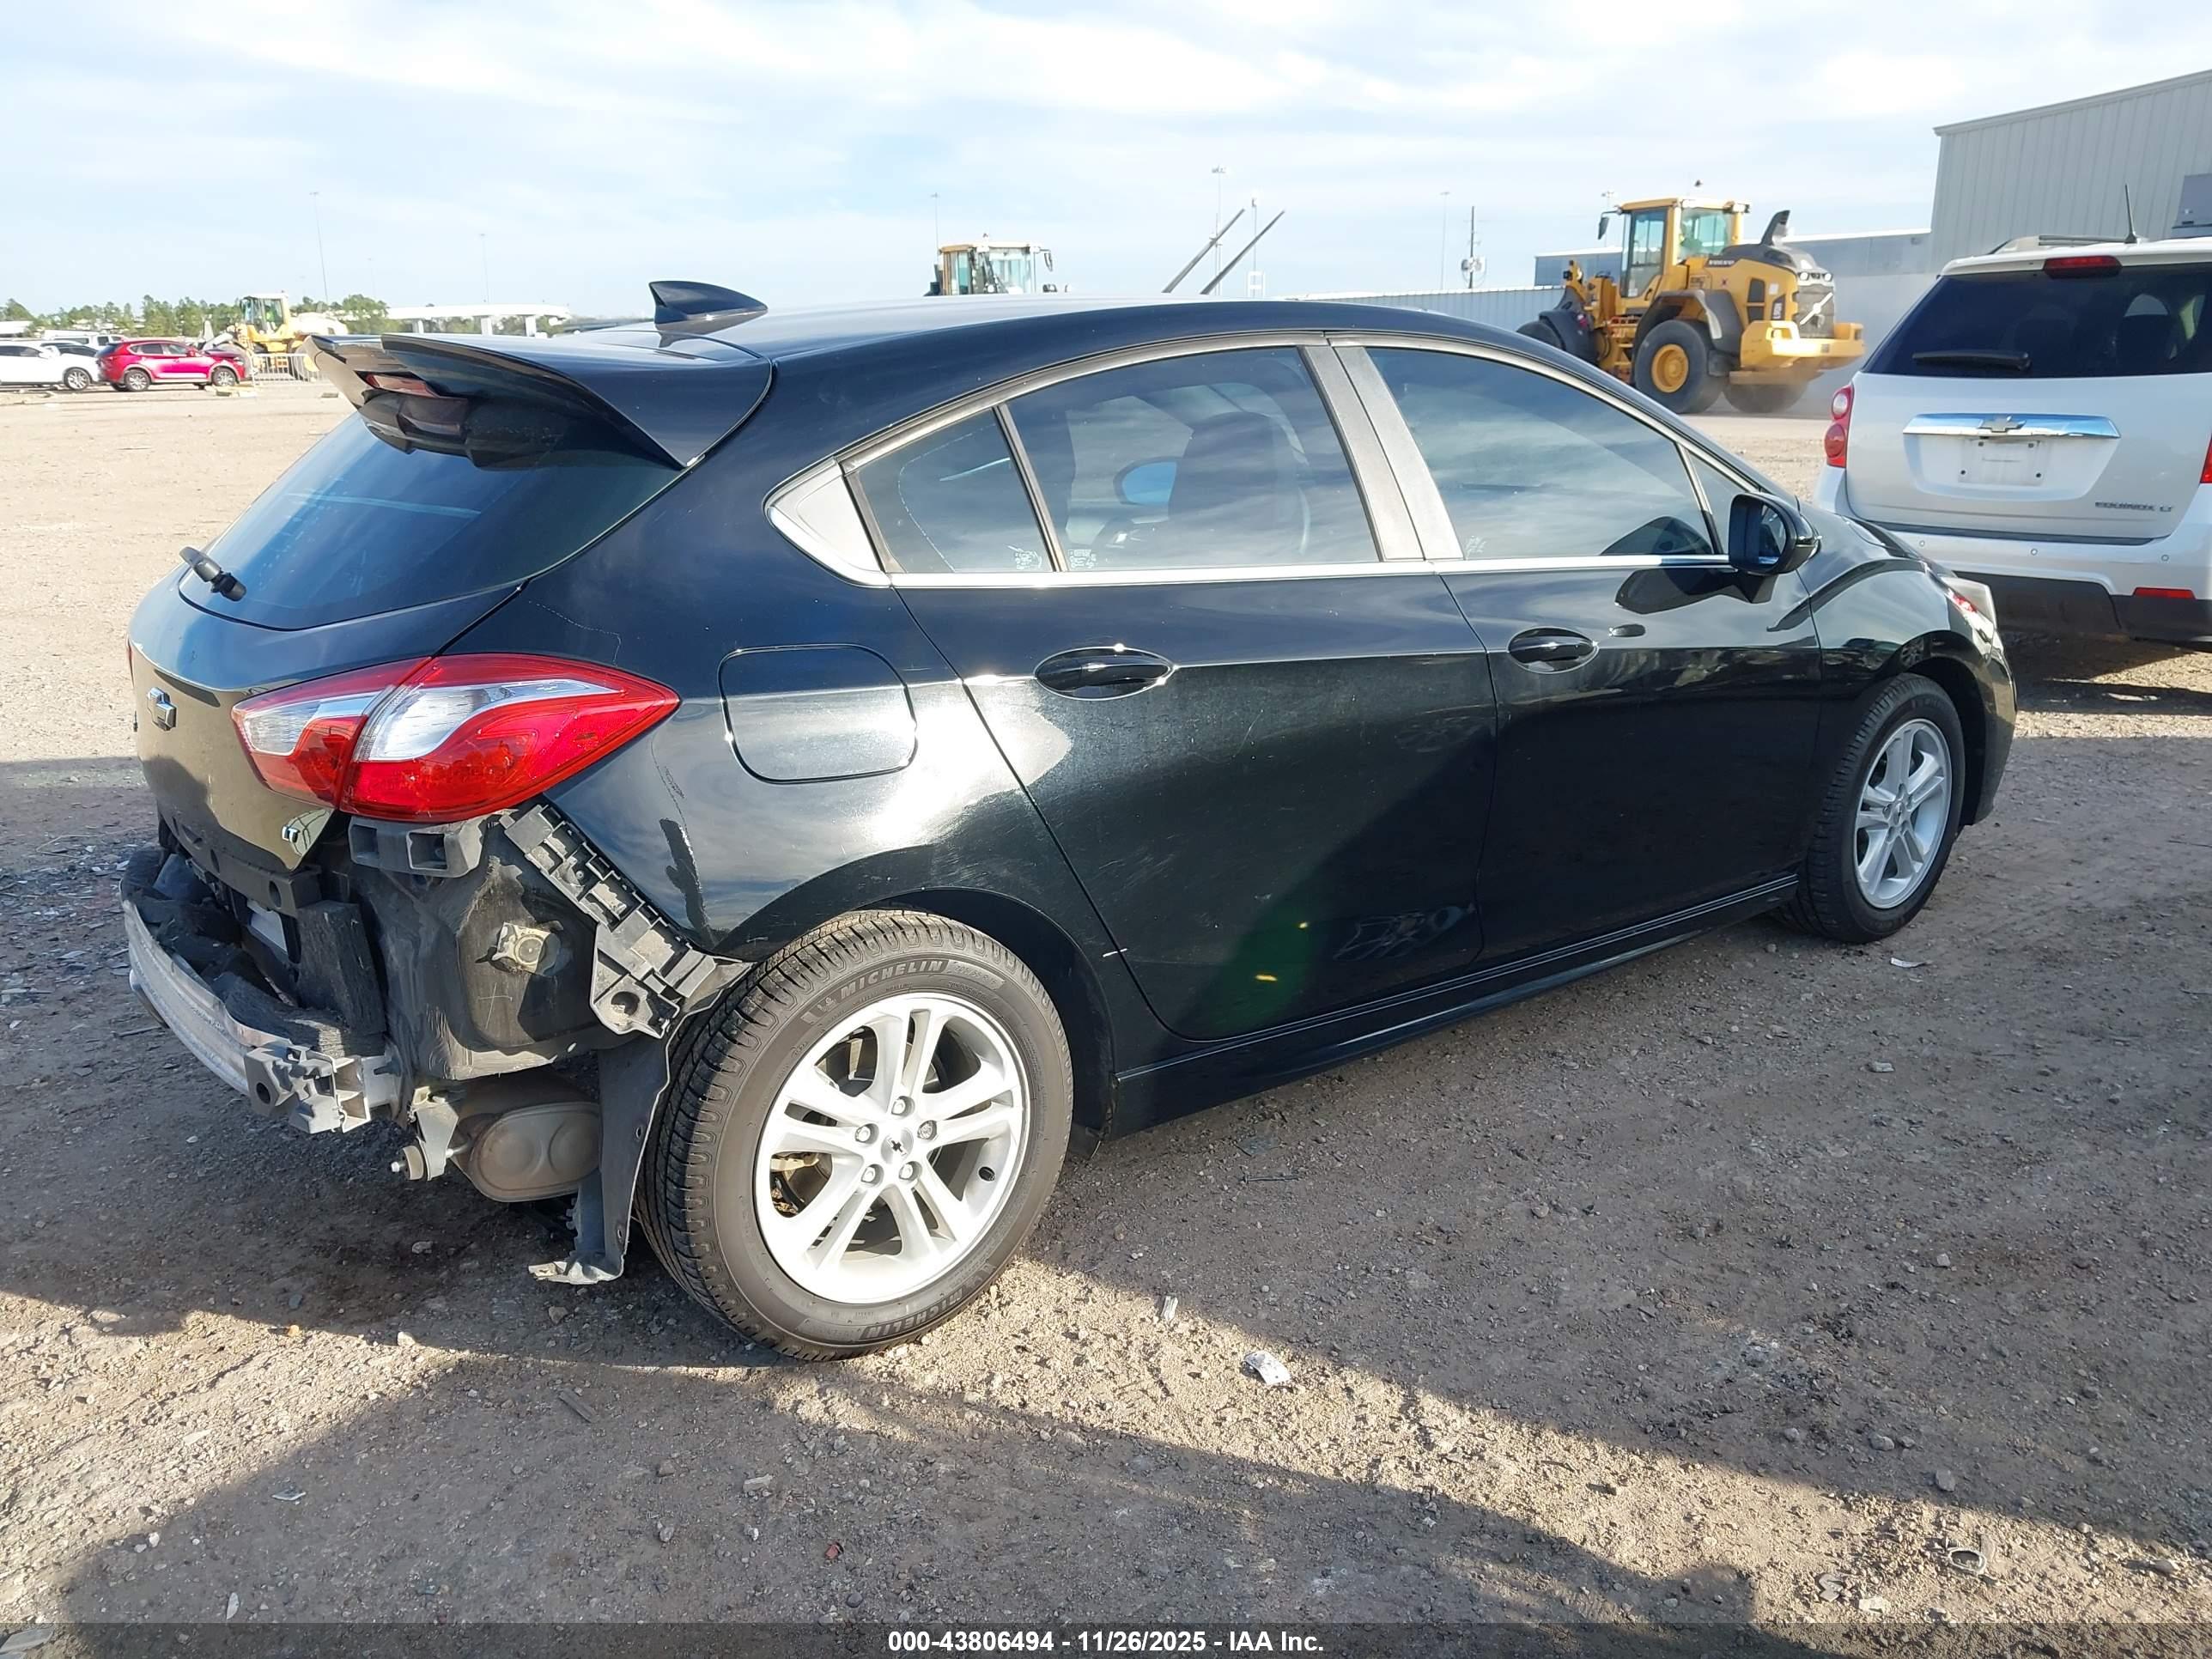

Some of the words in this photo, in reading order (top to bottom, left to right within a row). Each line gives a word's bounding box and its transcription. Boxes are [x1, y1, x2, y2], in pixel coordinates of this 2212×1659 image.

[2094, 501, 2155, 512] EQUINOX
[282, 825, 300, 842] LT
[841, 959, 943, 1000] MICHELIN
[866, 1288, 963, 1339] MICHELIN
